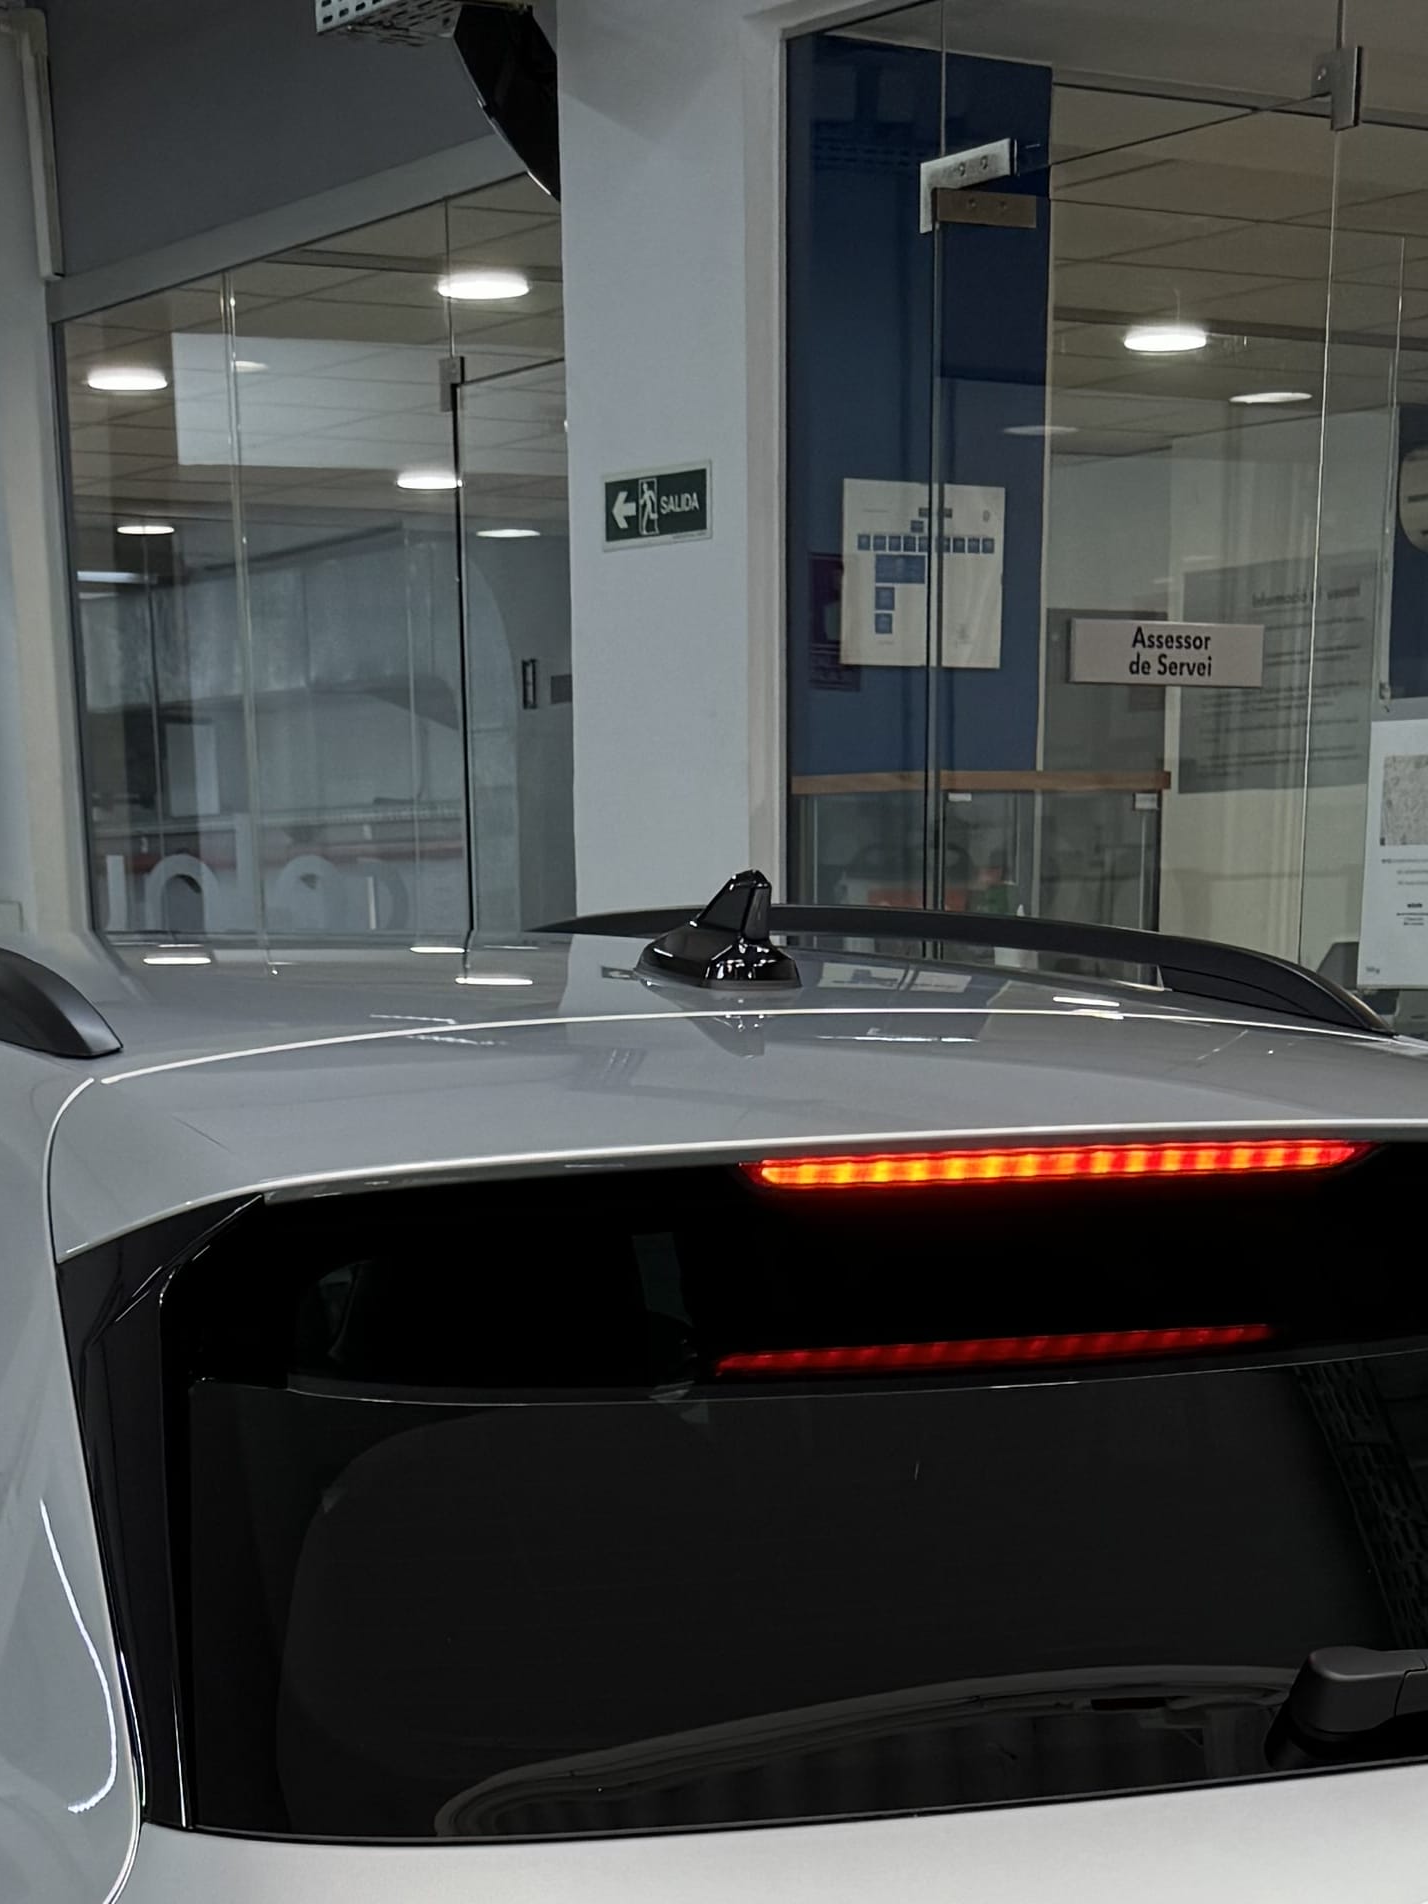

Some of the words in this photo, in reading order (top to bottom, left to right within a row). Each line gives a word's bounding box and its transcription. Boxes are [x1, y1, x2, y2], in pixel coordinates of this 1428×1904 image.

[660, 491, 700, 514] SALIDA
[1132, 626, 1211, 650] Assessor
[1129, 652, 1151, 675] de
[1157, 653, 1212, 677] Servei
